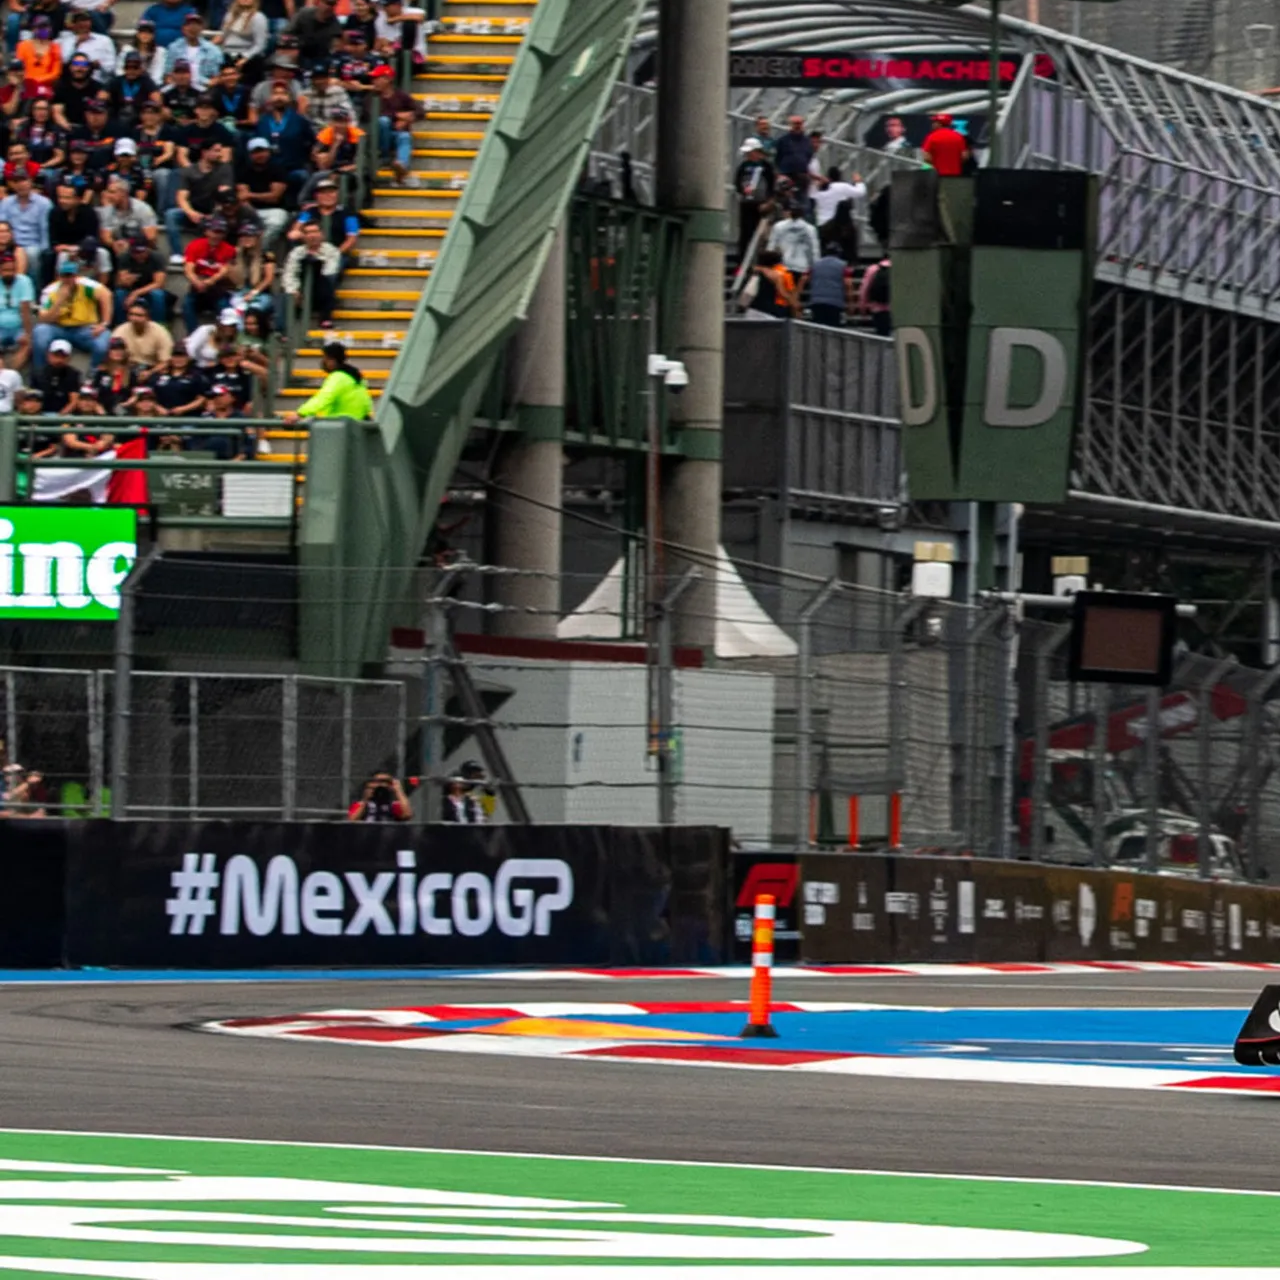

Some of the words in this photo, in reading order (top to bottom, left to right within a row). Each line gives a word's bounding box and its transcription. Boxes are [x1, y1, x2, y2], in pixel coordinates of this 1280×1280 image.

[802, 57, 1017, 81] SCHUMACHER
[896, 326, 938, 426] D
[983, 327, 1068, 428] D
[164, 849, 575, 938] #MexicoGP
